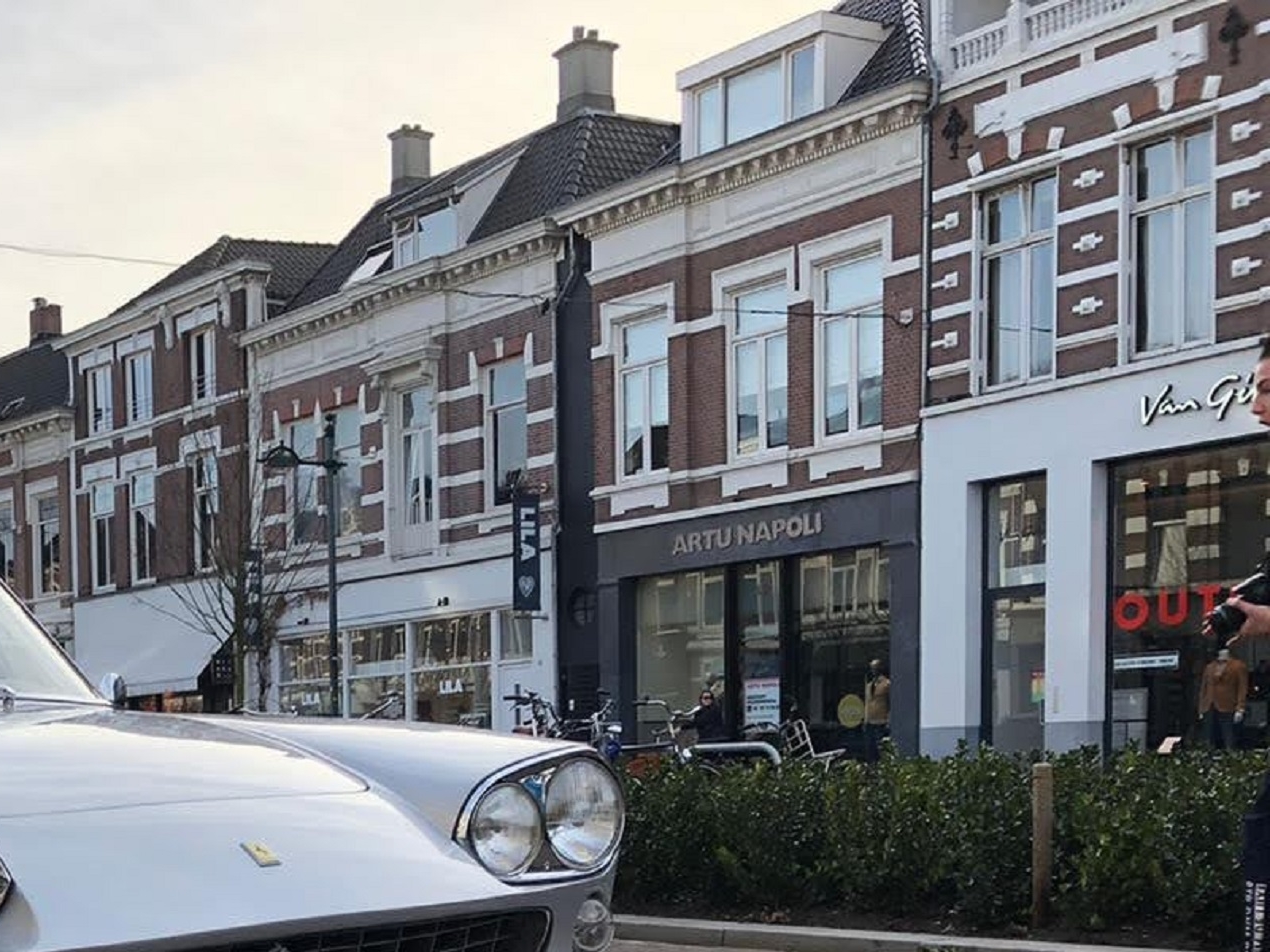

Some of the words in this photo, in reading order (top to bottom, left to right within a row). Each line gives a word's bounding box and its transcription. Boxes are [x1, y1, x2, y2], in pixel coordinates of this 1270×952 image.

[1141, 384, 1201, 425] Van
[520, 507, 536, 562] LILA
[672, 527, 732, 555] ARTU
[736, 511, 823, 545] NAPOLI
[1114, 584, 1223, 631] OUT
